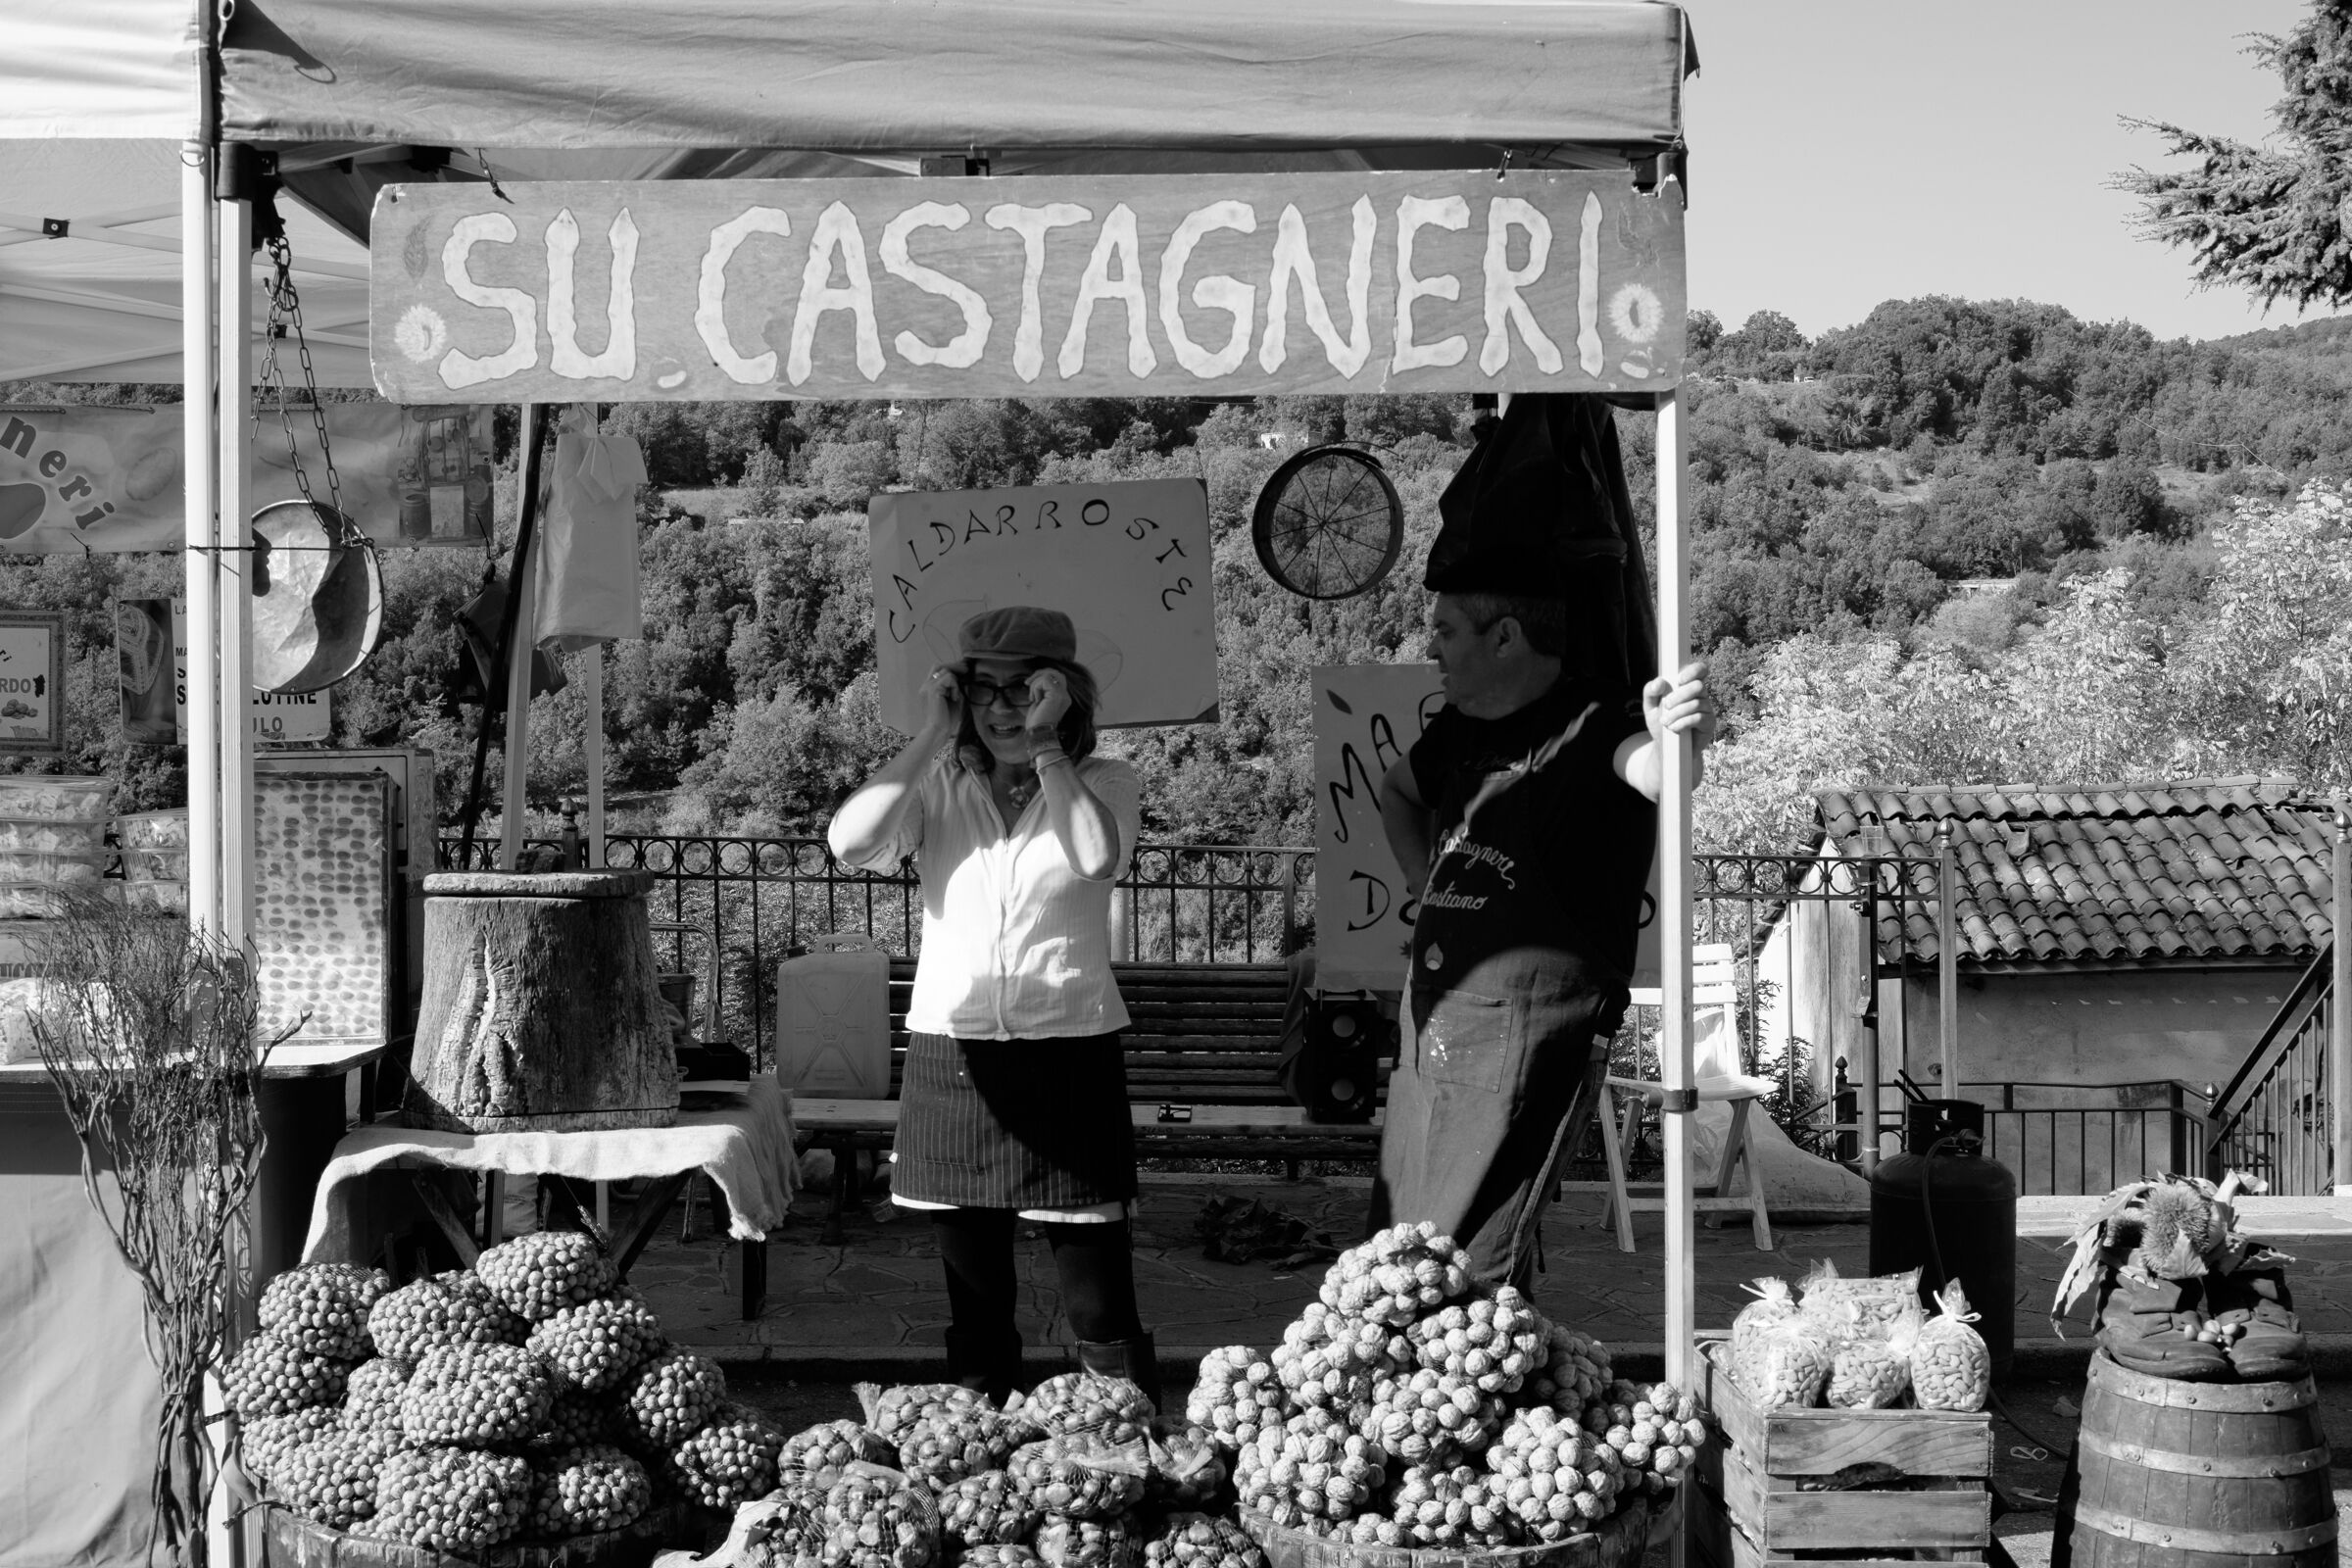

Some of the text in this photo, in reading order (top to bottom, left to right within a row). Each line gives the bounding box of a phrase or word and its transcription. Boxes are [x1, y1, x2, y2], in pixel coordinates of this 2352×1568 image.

[438, 190, 1604, 390] SU CASTAGNERI
[889, 498, 1193, 643] CALDARROSTE
